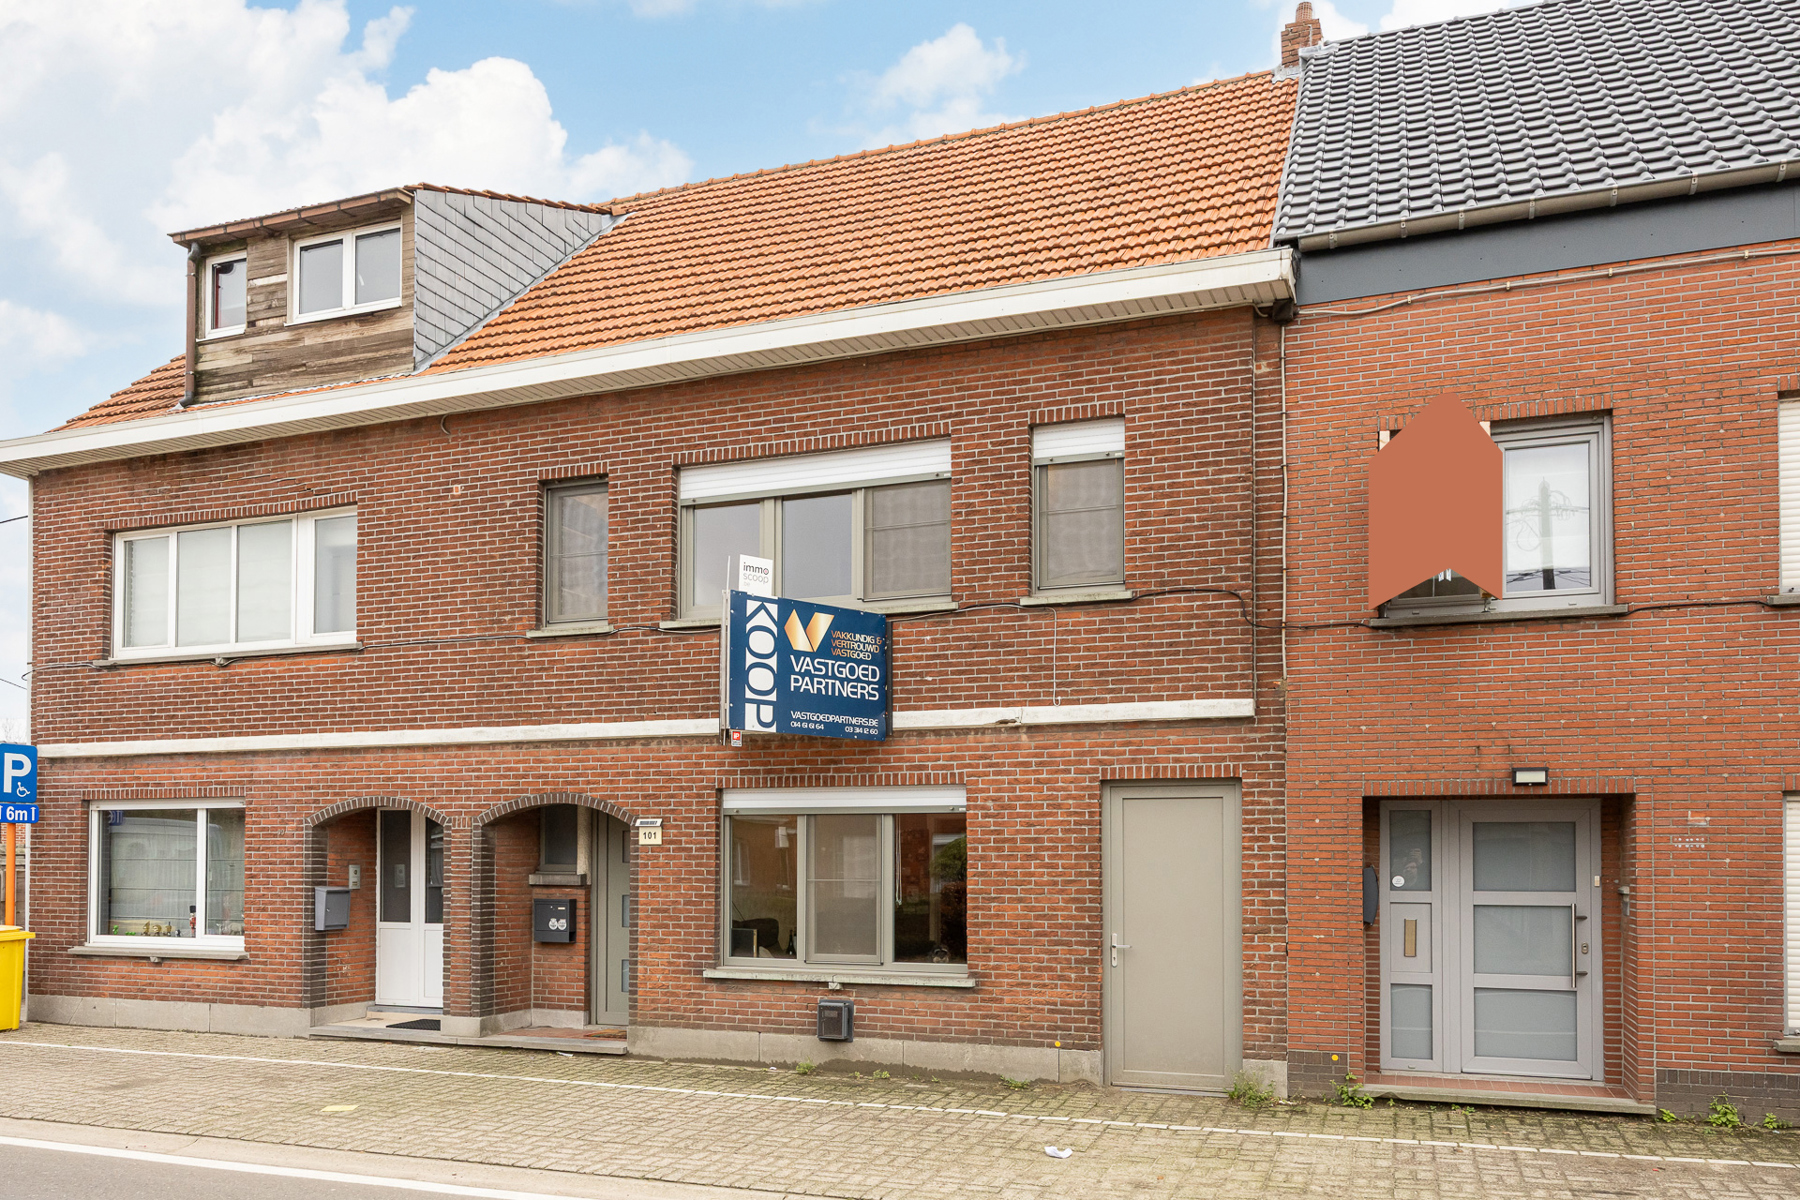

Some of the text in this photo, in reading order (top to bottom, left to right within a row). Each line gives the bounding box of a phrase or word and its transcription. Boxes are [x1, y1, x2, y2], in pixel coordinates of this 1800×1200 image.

[743, 561, 769, 575] immo
[743, 573, 769, 584] scoop
[830, 630, 882, 644] VAKKUNDIG &
[830, 639, 880, 653] VERTROUWD
[830, 648, 872, 660] VASTGOED
[745, 600, 778, 732] KOOP
[790, 654, 880, 682] VASTGOED
[790, 674, 879, 700] PARTNERS
[790, 710, 878, 727] VASTGOEDPARTNERS.BE
[4, 752, 32, 793] P
[6, 806, 28, 820] 6m
